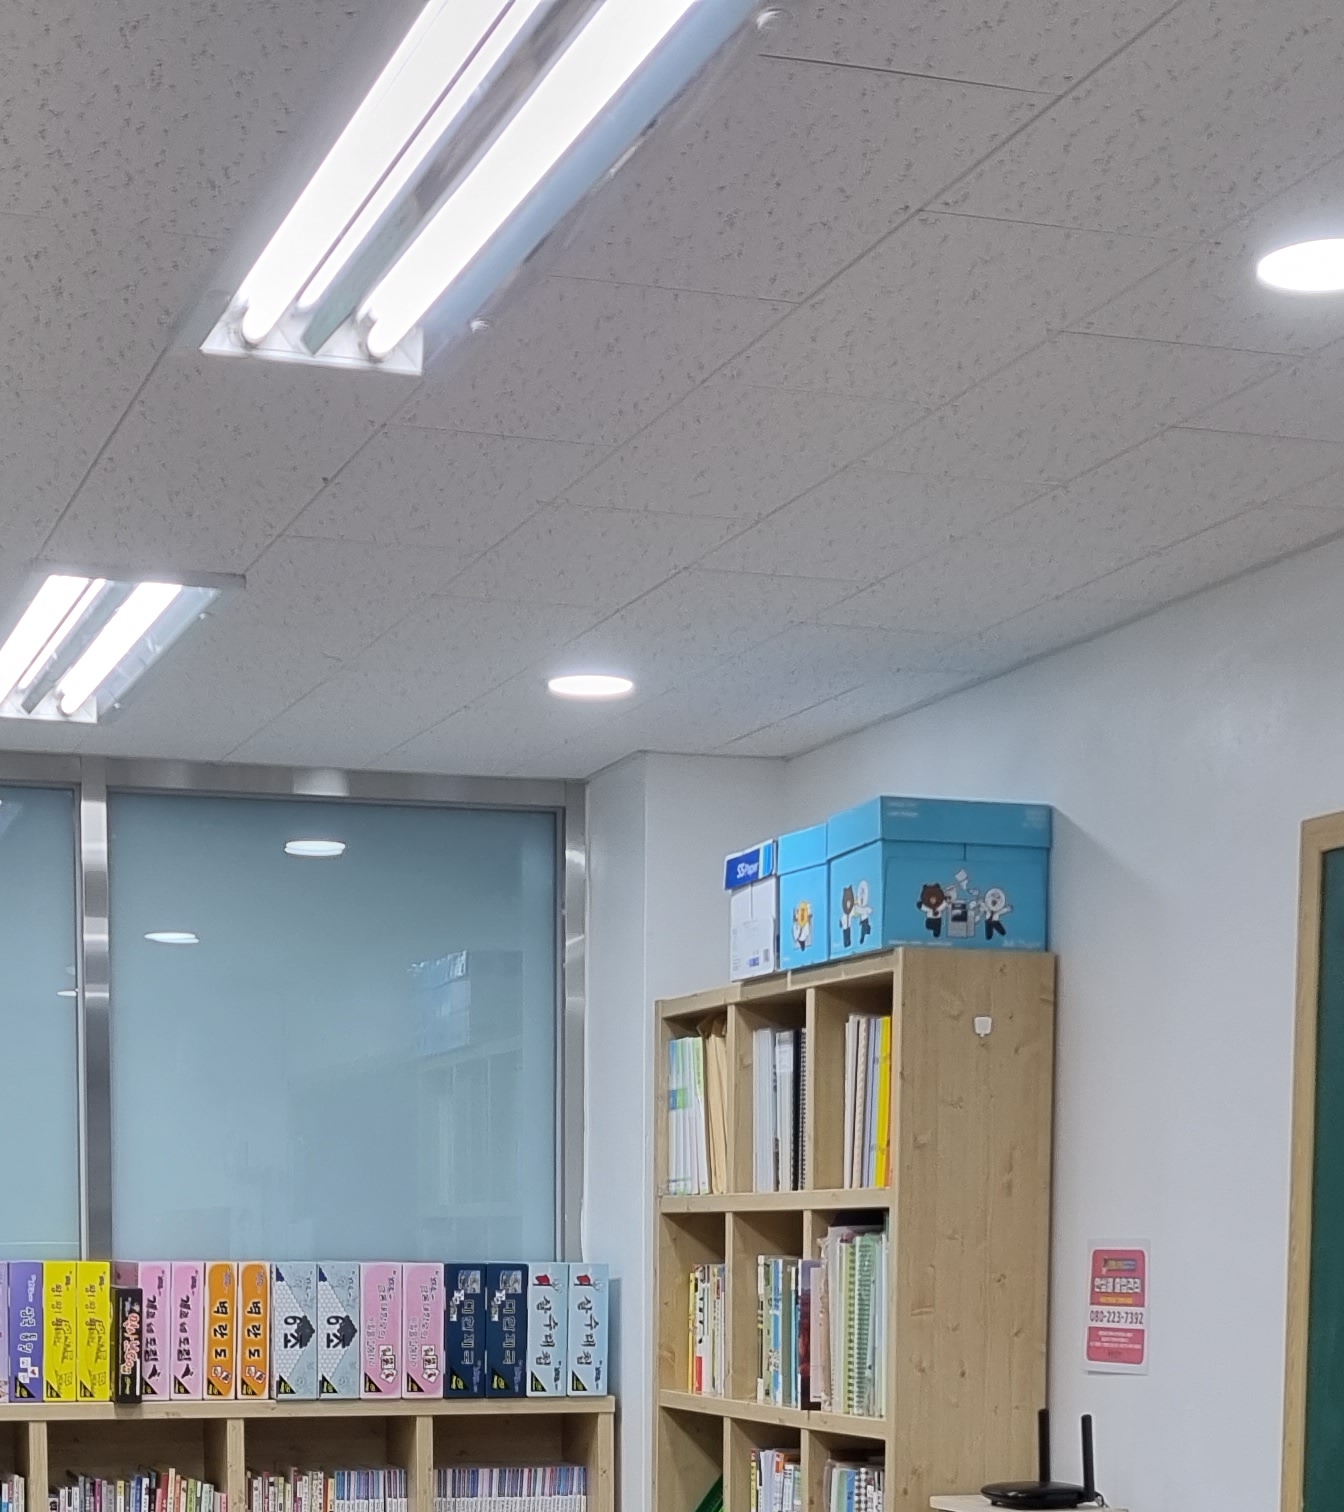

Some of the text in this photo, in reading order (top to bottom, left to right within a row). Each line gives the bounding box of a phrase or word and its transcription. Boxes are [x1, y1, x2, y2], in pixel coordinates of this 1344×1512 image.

[213, 1300, 229, 1360] 벽란도
[246, 1300, 262, 1360] 벽란도
[460, 1299, 476, 1365] 대한제국
[502, 1299, 517, 1365] 대한제국
[535, 1295, 559, 1366] 살수대첩
[576, 1295, 600, 1366] 살수대첩
